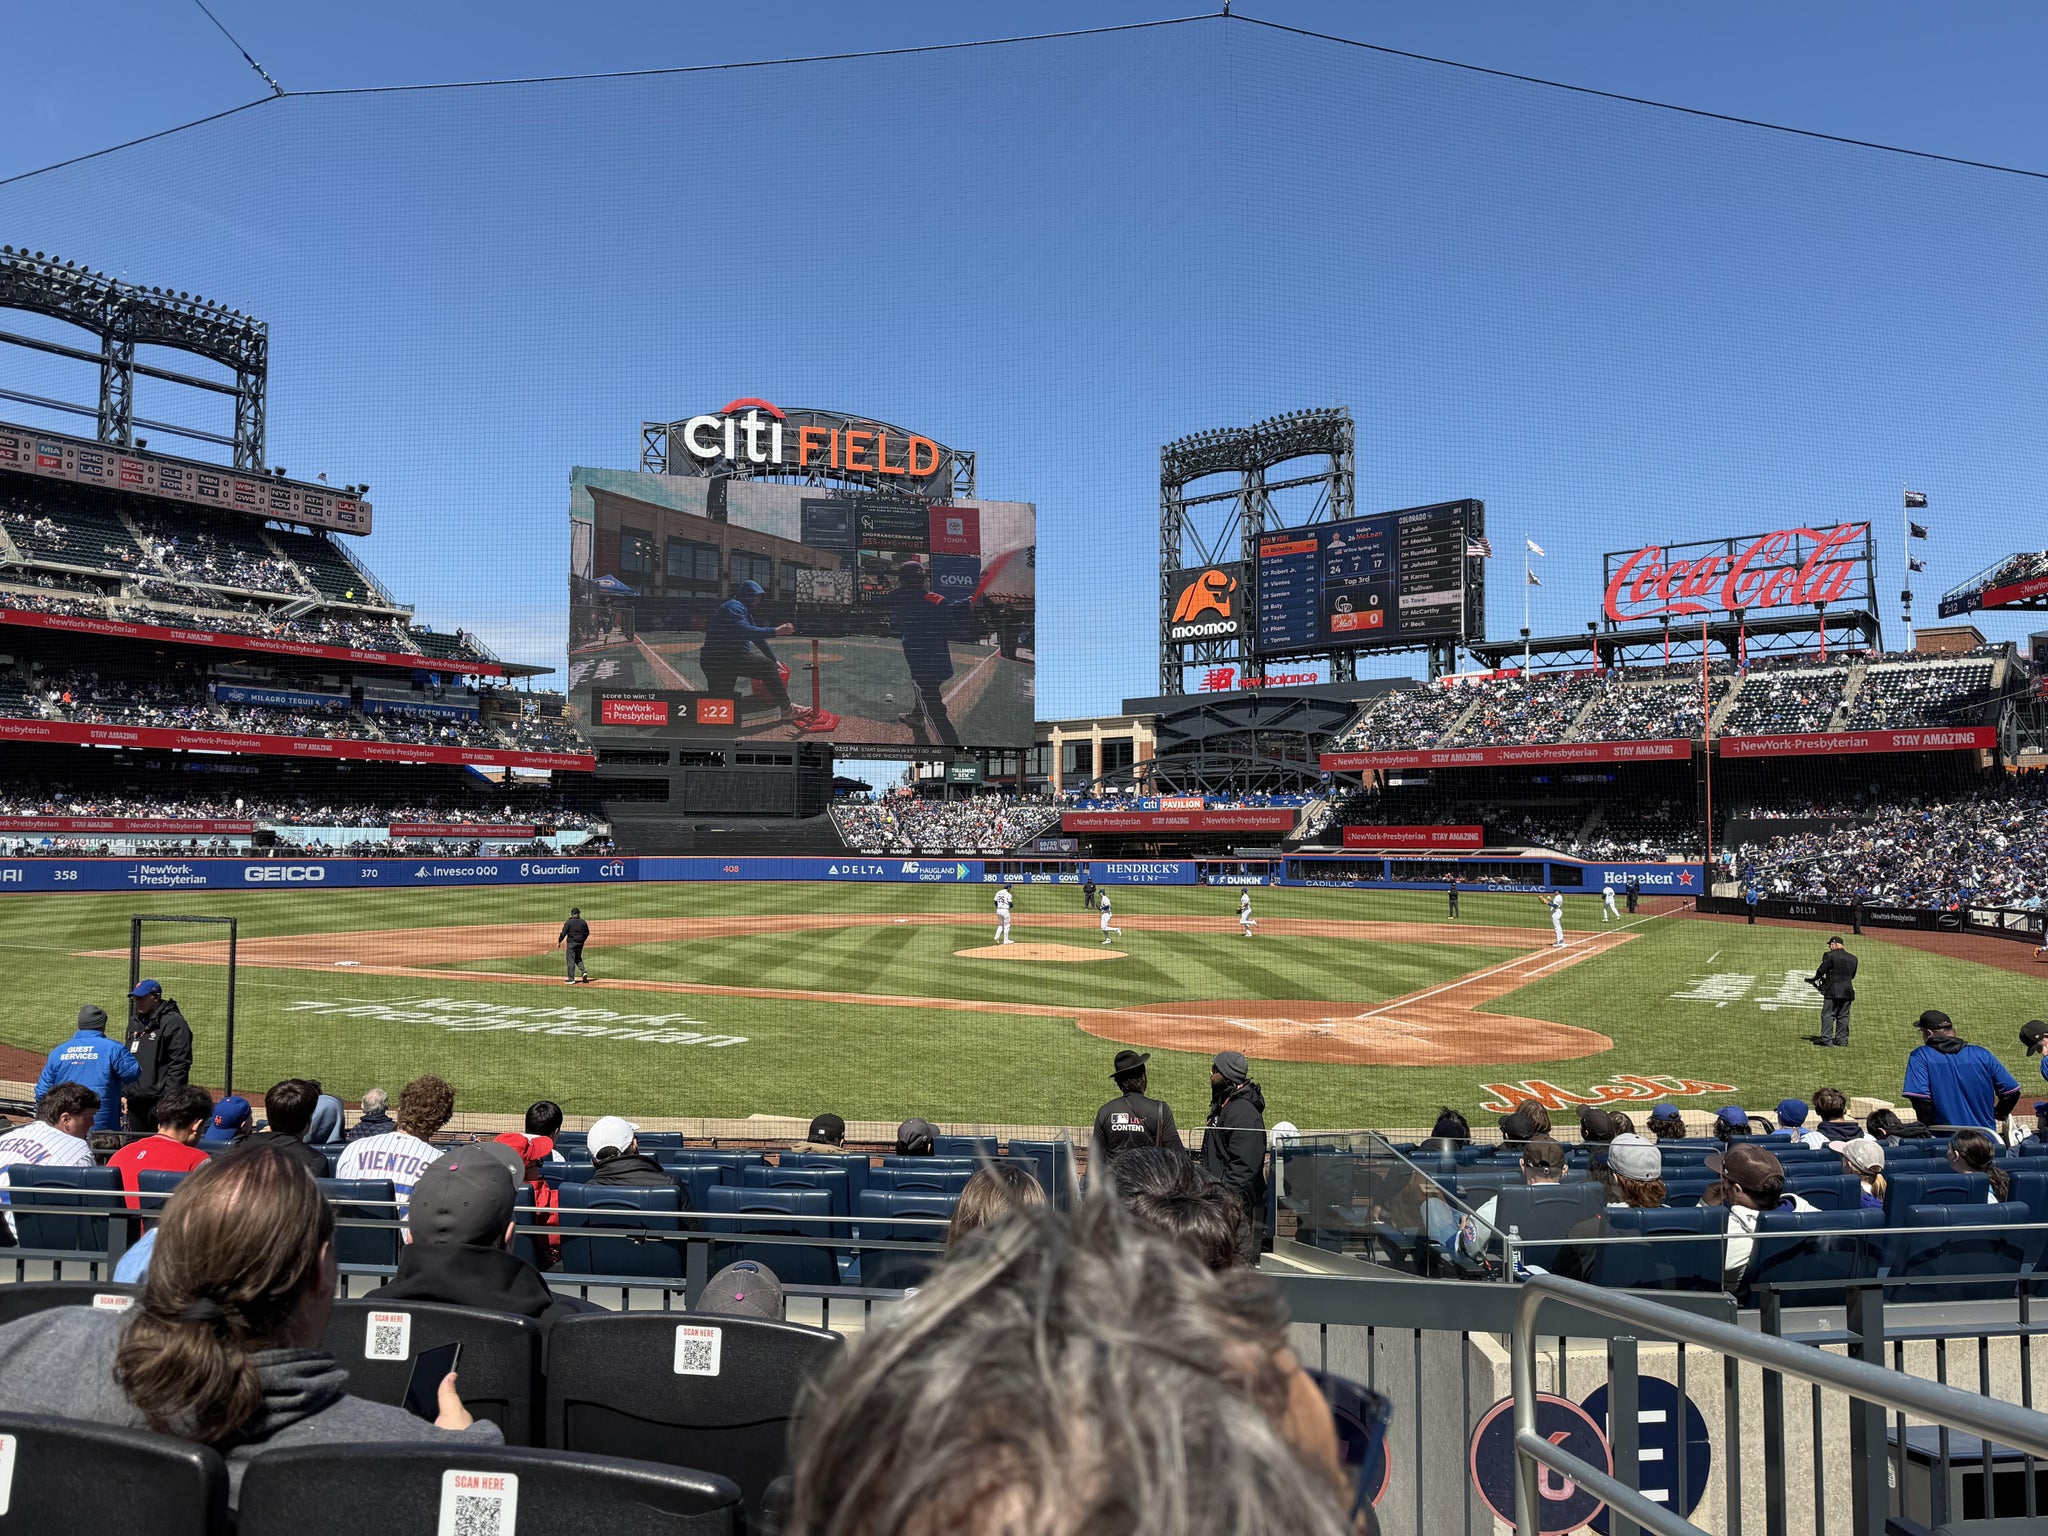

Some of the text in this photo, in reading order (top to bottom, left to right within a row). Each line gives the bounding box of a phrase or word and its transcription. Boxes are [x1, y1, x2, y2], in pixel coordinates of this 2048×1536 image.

[684, 409, 940, 476] citi FIELD
[41, 446, 60, 455] MIA
[81, 454, 103, 462] CHC
[80, 465, 102, 474] LAD
[122, 461, 143, 470] BOS
[122, 472, 142, 482] BAL
[162, 470, 181, 478] CLE
[162, 480, 182, 489] TOR
[200, 477, 218, 485] MIN
[236, 483, 255, 492] WSH
[236, 494, 255, 503] CWS
[271, 490, 290, 499] NYY
[271, 501, 289, 509] HOU
[306, 496, 323, 504] ATH
[338, 502, 355, 511] LAA
[1399, 512, 1427, 525] COLORADO
[1410, 525, 1428, 534] Julien
[1356, 531, 1383, 540] McLean
[1411, 537, 1432, 545] Moniak
[1411, 547, 1437, 556] Rumfield
[1354, 563, 1359, 572] 7
[1374, 560, 1382, 568] 17
[1410, 560, 1438, 568] Johnston
[1330, 566, 1340, 574] 24
[1604, 521, 1870, 621] Coca-Cola
[940, 575, 972, 586] GOYA
[1359, 576, 1370, 584] 3rd
[1410, 585, 1433, 593] Sullivan
[1370, 594, 1379, 606] 0
[1411, 608, 1439, 616] McCarthy
[1370, 613, 1379, 624] 0
[49, 617, 137, 634] NewYork-Presbyterian
[1172, 621, 1237, 639] moomoo
[171, 631, 214, 642] STAY AMAZING
[250, 640, 323, 655] NewYork-Presbyterian
[350, 651, 387, 662] STAY AMAZING
[416, 659, 479, 671] NewYork-Presbyterian
[1238, 672, 1318, 688] new balance
[251, 695, 286, 704] MILAGRO
[288, 698, 320, 706] TEQUILA
[614, 703, 654, 712] NewYork-
[678, 705, 687, 716] 2
[704, 706, 728, 718] :22
[442, 710, 456, 718] BAR
[614, 712, 666, 722] Presbyterian
[91, 731, 138, 741] STAY AMAZING
[1892, 732, 1975, 747] STAY AMAZING
[181, 736, 261, 748] NewYork-Presbyterian
[1741, 736, 1869, 751] NewYork-Presbyterian
[307, 744, 333, 752] AMAZING
[368, 747, 434, 759] NewYork-Presbyterian
[1614, 745, 1673, 757] STAY AMAZING
[1432, 752, 1483, 763] STAY AMAZING
[1503, 748, 1598, 761] NewYork-Presbyterian
[1337, 755, 1418, 767] NewYork-Presbyterian
[1143, 799, 1201, 810] citi PAVILION
[86, 821, 113, 829] AMAZING
[130, 821, 203, 831] NewYork-Presbyterian
[1077, 817, 1141, 827] NewYork-Presbyterian
[1206, 816, 1280, 826] NewYork-Presbyterian
[228, 823, 251, 831] AMAZING
[1351, 832, 1426, 842] NewYork-Presbyterian
[1431, 832, 1479, 841] STAY AMAZING
[140, 864, 193, 875] NewYork-
[434, 865, 498, 877] Invesco QQQ
[532, 864, 580, 876] Guardian
[600, 862, 624, 876] citi
[723, 865, 740, 873] 408
[842, 865, 884, 875] DELTA
[902, 862, 955, 875] HG HAUGLAND
[1107, 862, 1180, 874] HENDRICK'S
[54, 870, 78, 880] 358
[244, 866, 325, 882] GEICO
[361, 868, 378, 879] 370
[983, 873, 997, 882] 380
[1003, 874, 1024, 882] GOYA
[1031, 874, 1051, 882] GOYA
[1059, 874, 1079, 882] GOYA
[1134, 874, 1155, 882] GIN
[140, 874, 207, 887] Presbyterian
[1227, 875, 1263, 885] DUNKIN'
[1306, 880, 1354, 888] CADILLAC
[1488, 884, 1547, 893] CADILLAC
[1796, 906, 1817, 915] DELTA
[1872, 912, 1917, 923] NewYork-Presbyterian
[388, 998, 707, 1026] NewYork-
[312, 1006, 749, 1046] Presbyterian
[67, 1045, 95, 1053] GUEST
[60, 1053, 98, 1061] SERVICES
[1479, 1074, 1739, 1113] Mets
[136, 1150, 147, 1160] 8
[100, 1296, 128, 1306] SCAN HERE
[374, 1313, 403, 1323] SCAN HERE
[683, 1328, 714, 1337] SCAN HERE
[454, 1475, 505, 1491] SCAN HERE
